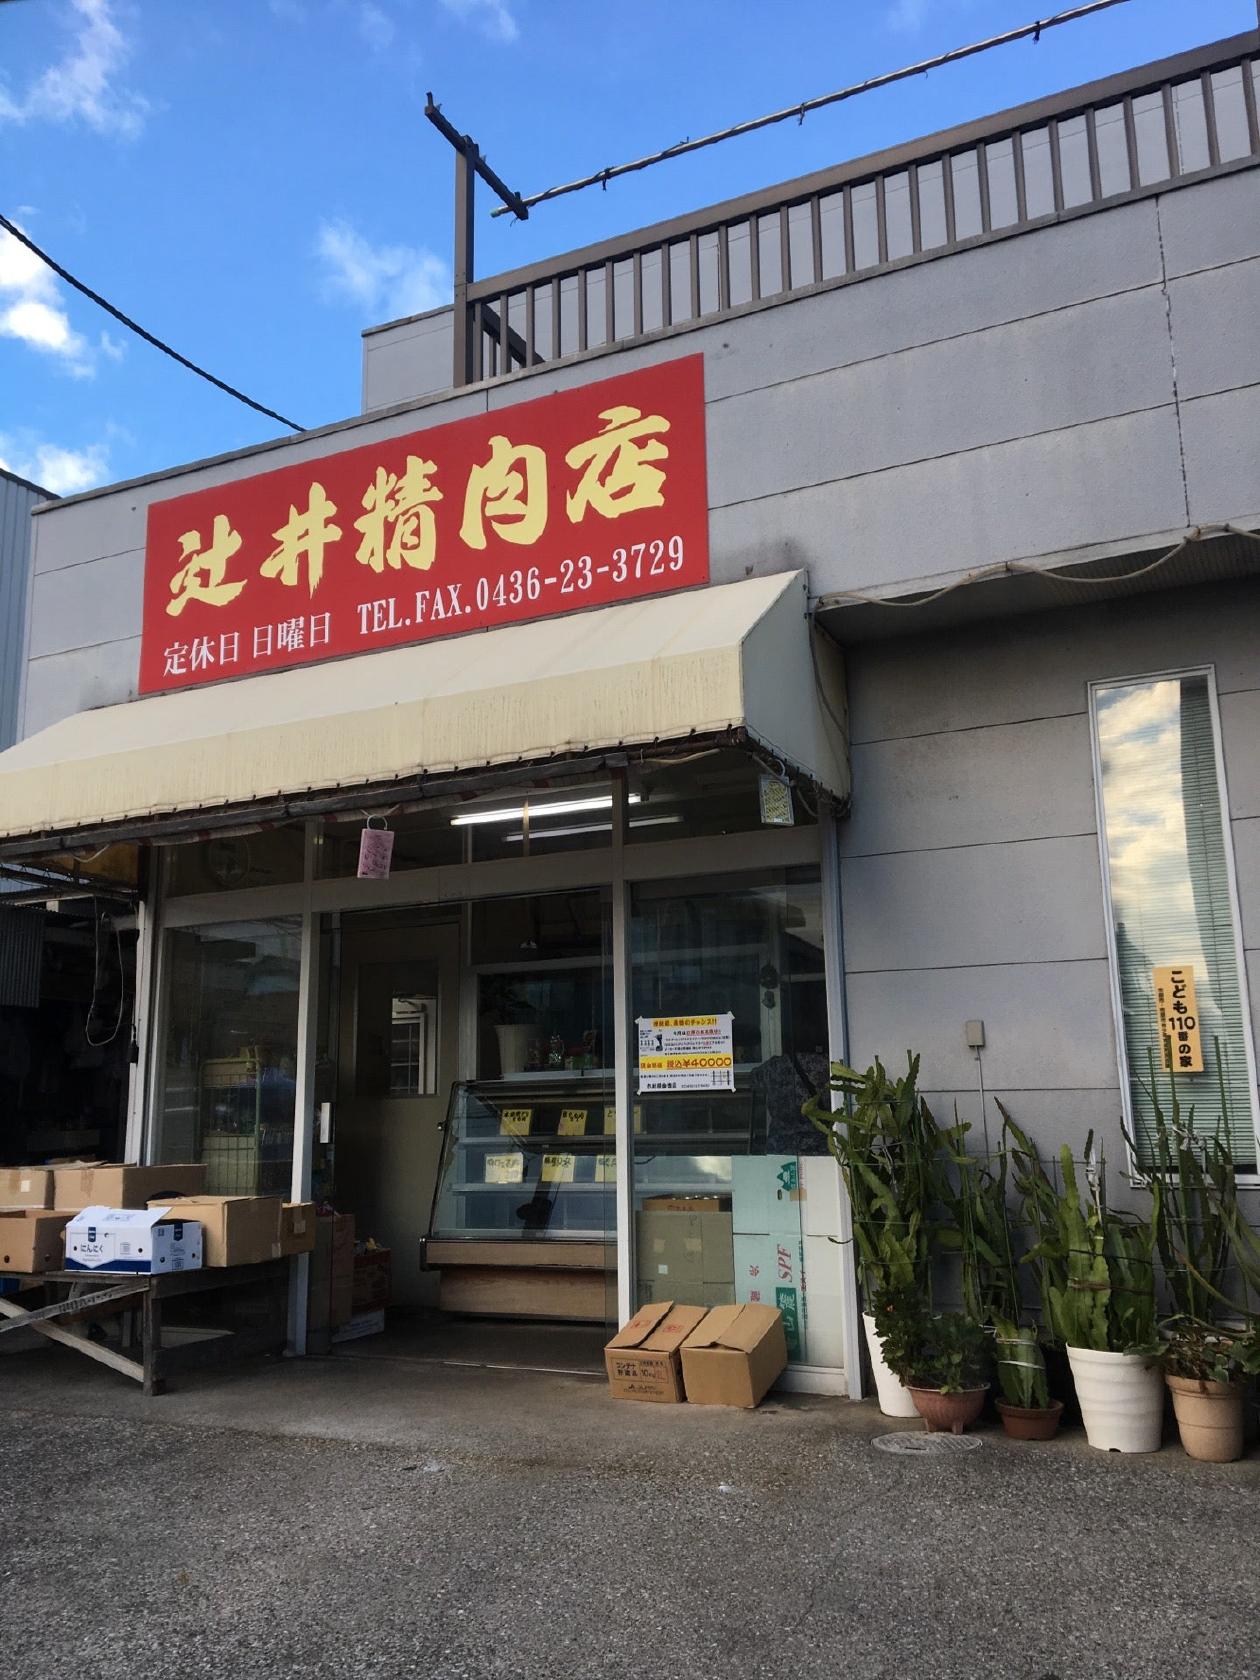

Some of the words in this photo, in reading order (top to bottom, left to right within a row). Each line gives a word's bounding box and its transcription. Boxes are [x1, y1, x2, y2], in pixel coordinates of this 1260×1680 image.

[165, 404, 671, 618] 辻井精肉店
[163, 631, 240, 678] 定休日
[252, 611, 331, 659] 日曜日
[1168, 970, 1196, 1068] こども110番の家
[80, 1243, 103, 1252] にんにく
[776, 1243, 793, 1283] SPF
